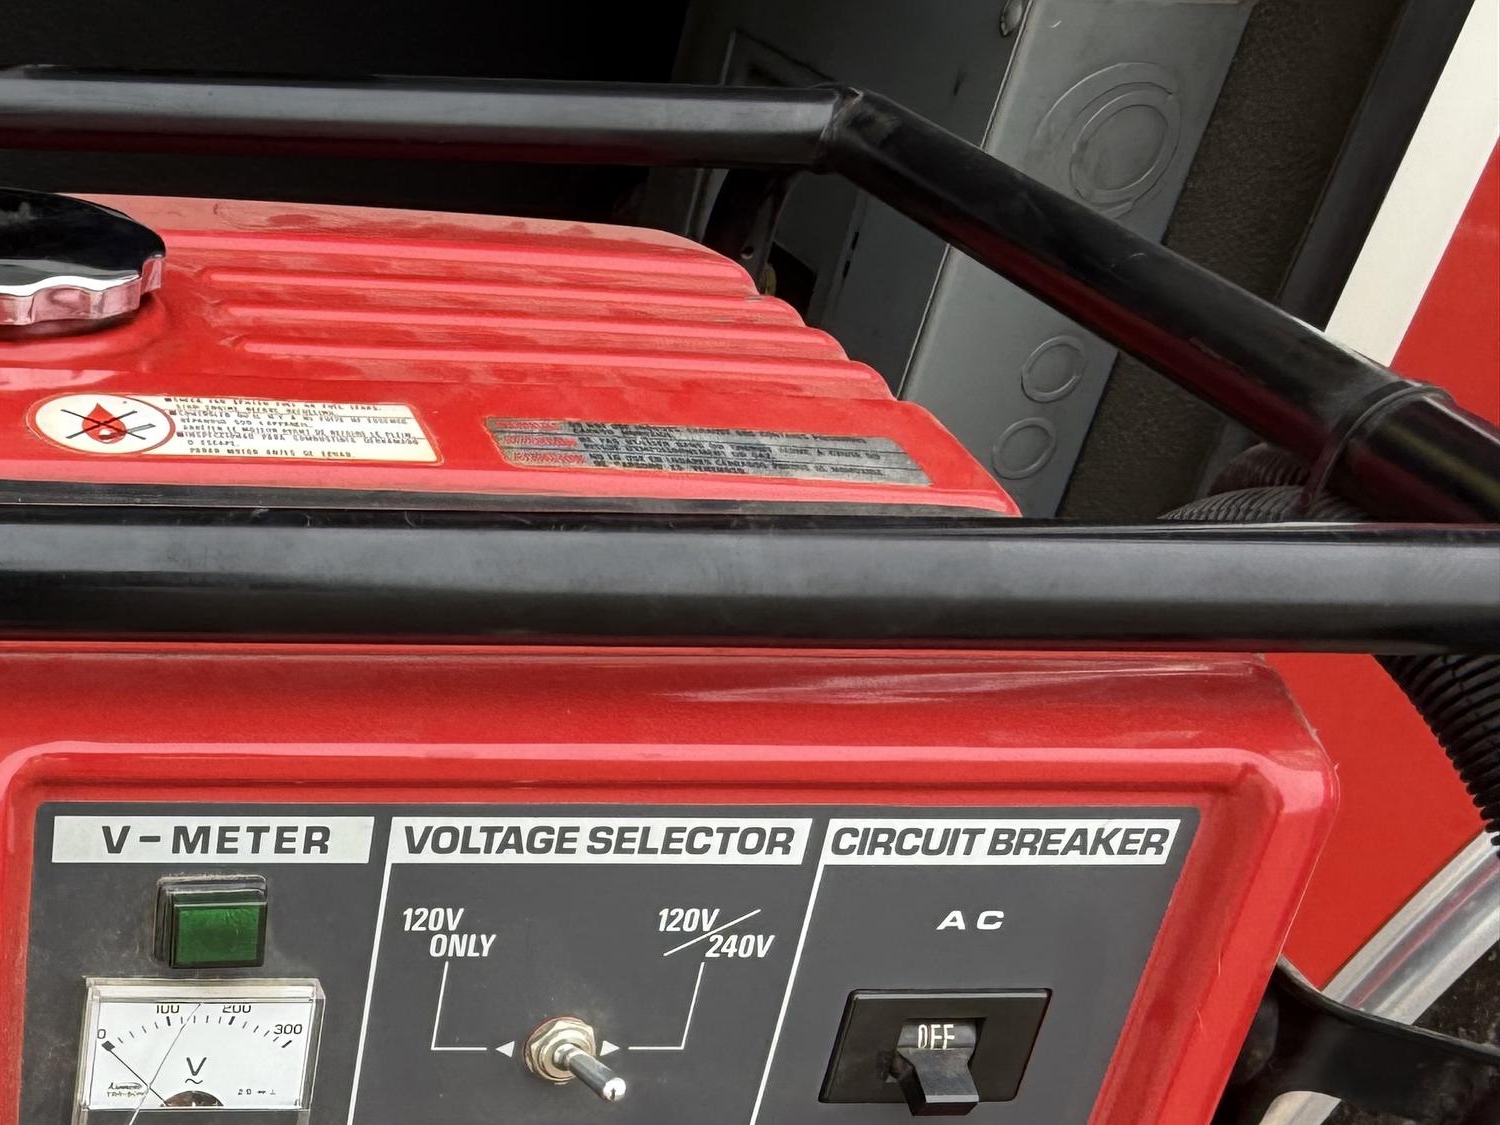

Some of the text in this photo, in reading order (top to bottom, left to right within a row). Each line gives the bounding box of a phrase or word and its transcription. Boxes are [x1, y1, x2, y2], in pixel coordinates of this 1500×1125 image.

[101, 825, 331, 855] V-METER
[404, 826, 796, 856] VOLTAGE SELECTOR
[831, 827, 1171, 855] CIRCUIT BREAKER
[402, 908, 465, 931] 120V
[429, 934, 497, 958] ONLY
[156, 1004, 251, 1014] 100 200
[273, 1023, 303, 1035] 300
[917, 1024, 955, 1049] OFF
[186, 1057, 207, 1076] V
